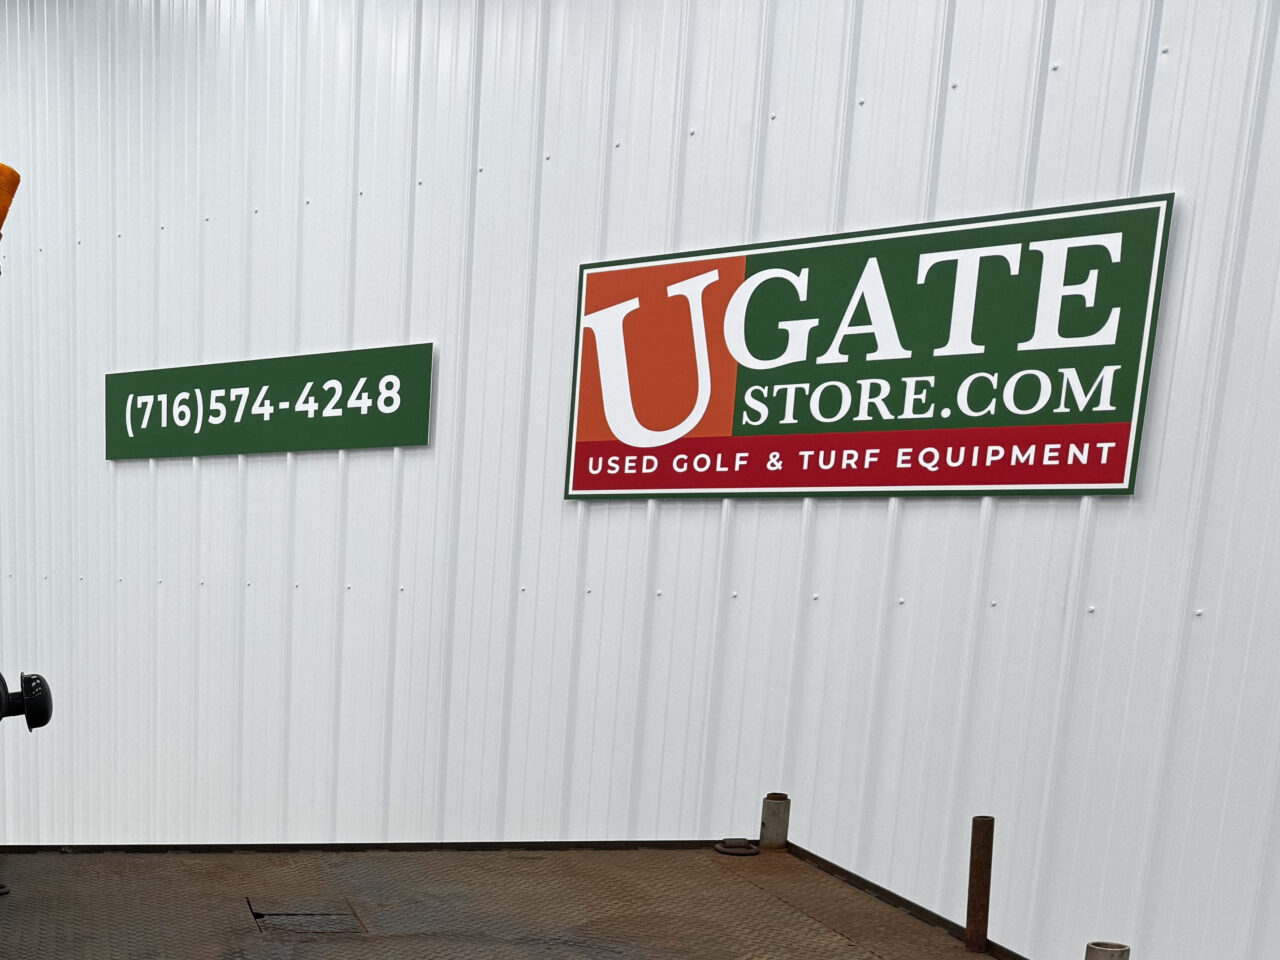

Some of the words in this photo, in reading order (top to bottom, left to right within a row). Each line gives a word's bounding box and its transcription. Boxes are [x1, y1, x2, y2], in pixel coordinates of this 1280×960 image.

[583, 232, 1123, 448] UGATE
[125, 374, 401, 438] (716)574-4248
[741, 364, 1122, 426] STORE.COM
[588, 455, 659, 475] USED
[672, 452, 749, 473] GOLF
[766, 451, 783, 471] &
[798, 448, 881, 470] TURF
[896, 442, 1117, 472] EQUIPMENT
